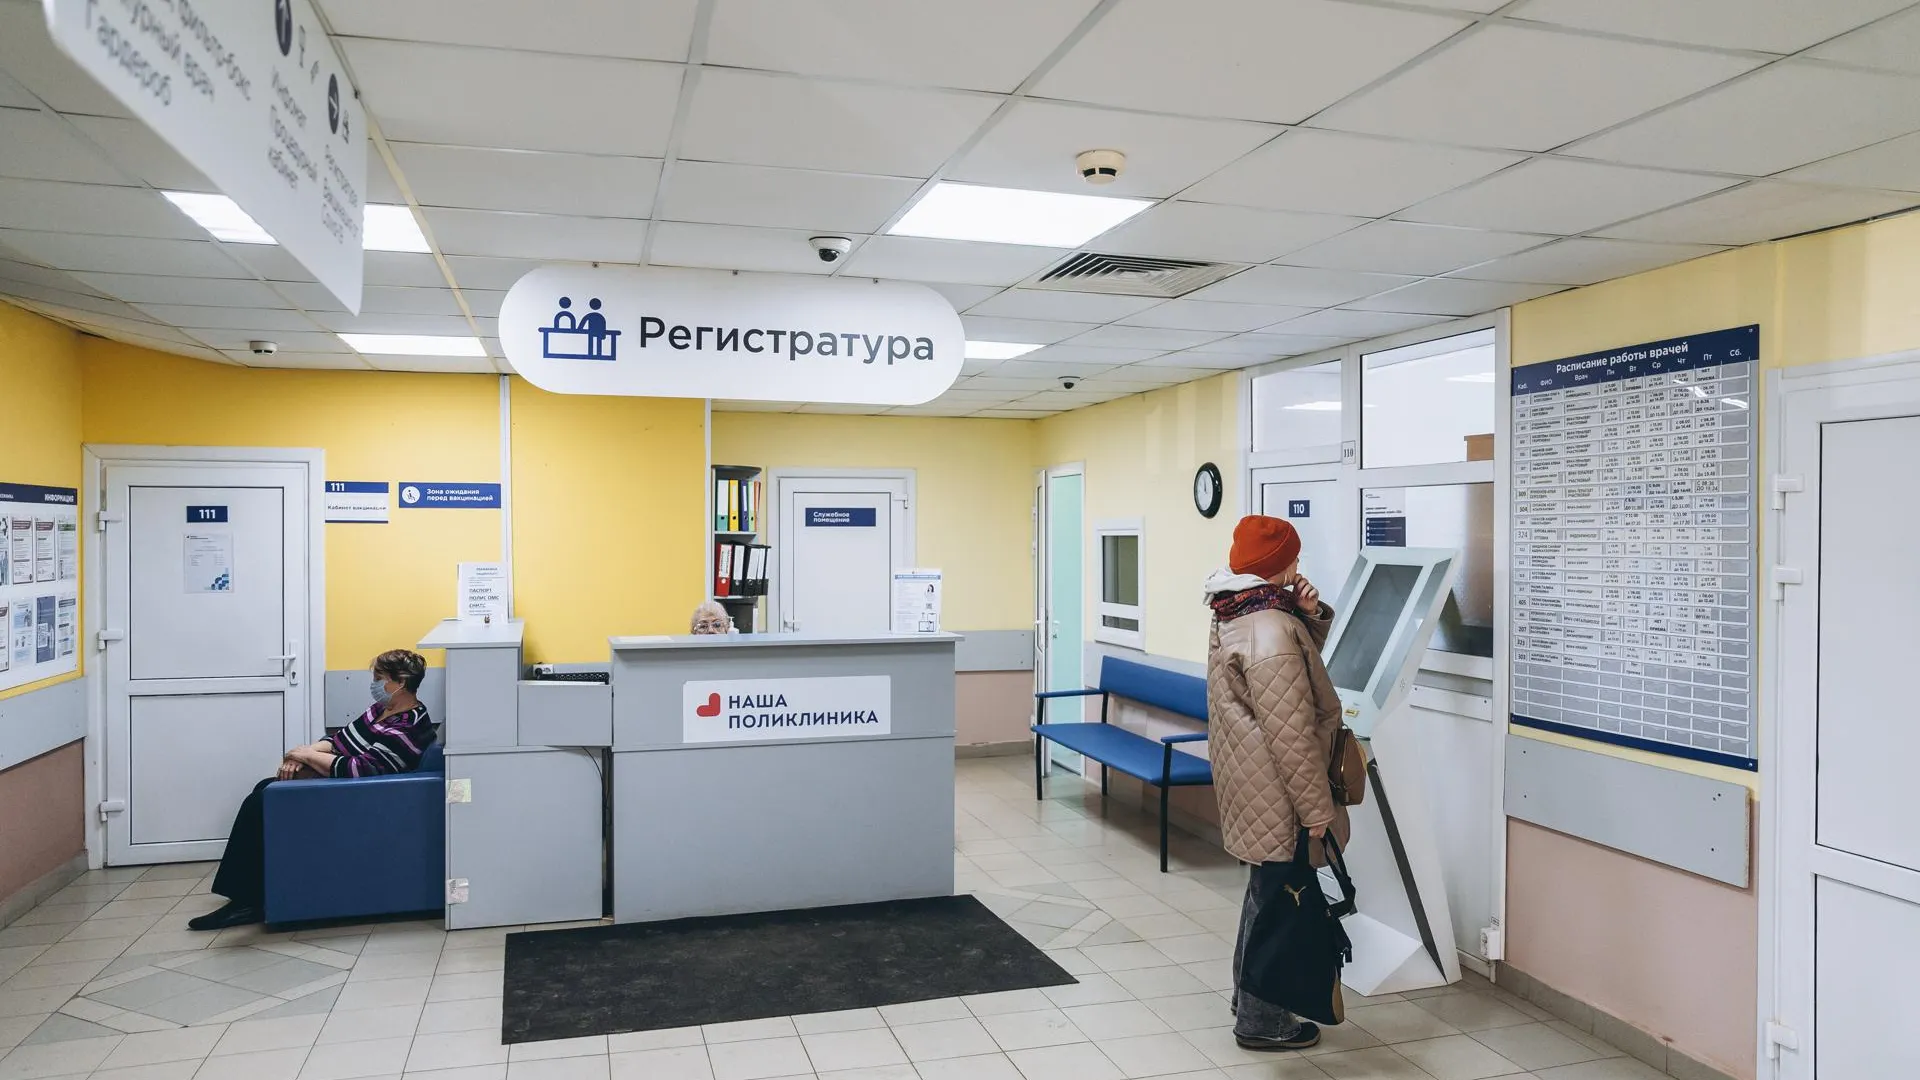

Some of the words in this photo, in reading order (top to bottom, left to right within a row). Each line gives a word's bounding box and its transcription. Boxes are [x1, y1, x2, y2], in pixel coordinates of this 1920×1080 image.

[639, 315, 934, 365] Регистратура
[1556, 357, 1608, 374] Расписание
[1610, 348, 1647, 365] работы
[1650, 341, 1688, 358] врачей
[1574, 374, 1588, 382] Врач
[1730, 348, 1742, 357] Сб.
[1344, 448, 1354, 458] 110
[330, 482, 345, 492] 111
[199, 509, 216, 519] 111
[1293, 504, 1304, 514] 110
[728, 694, 788, 709] НАША
[728, 710, 879, 729] ПОЛИКЛИНИКА
